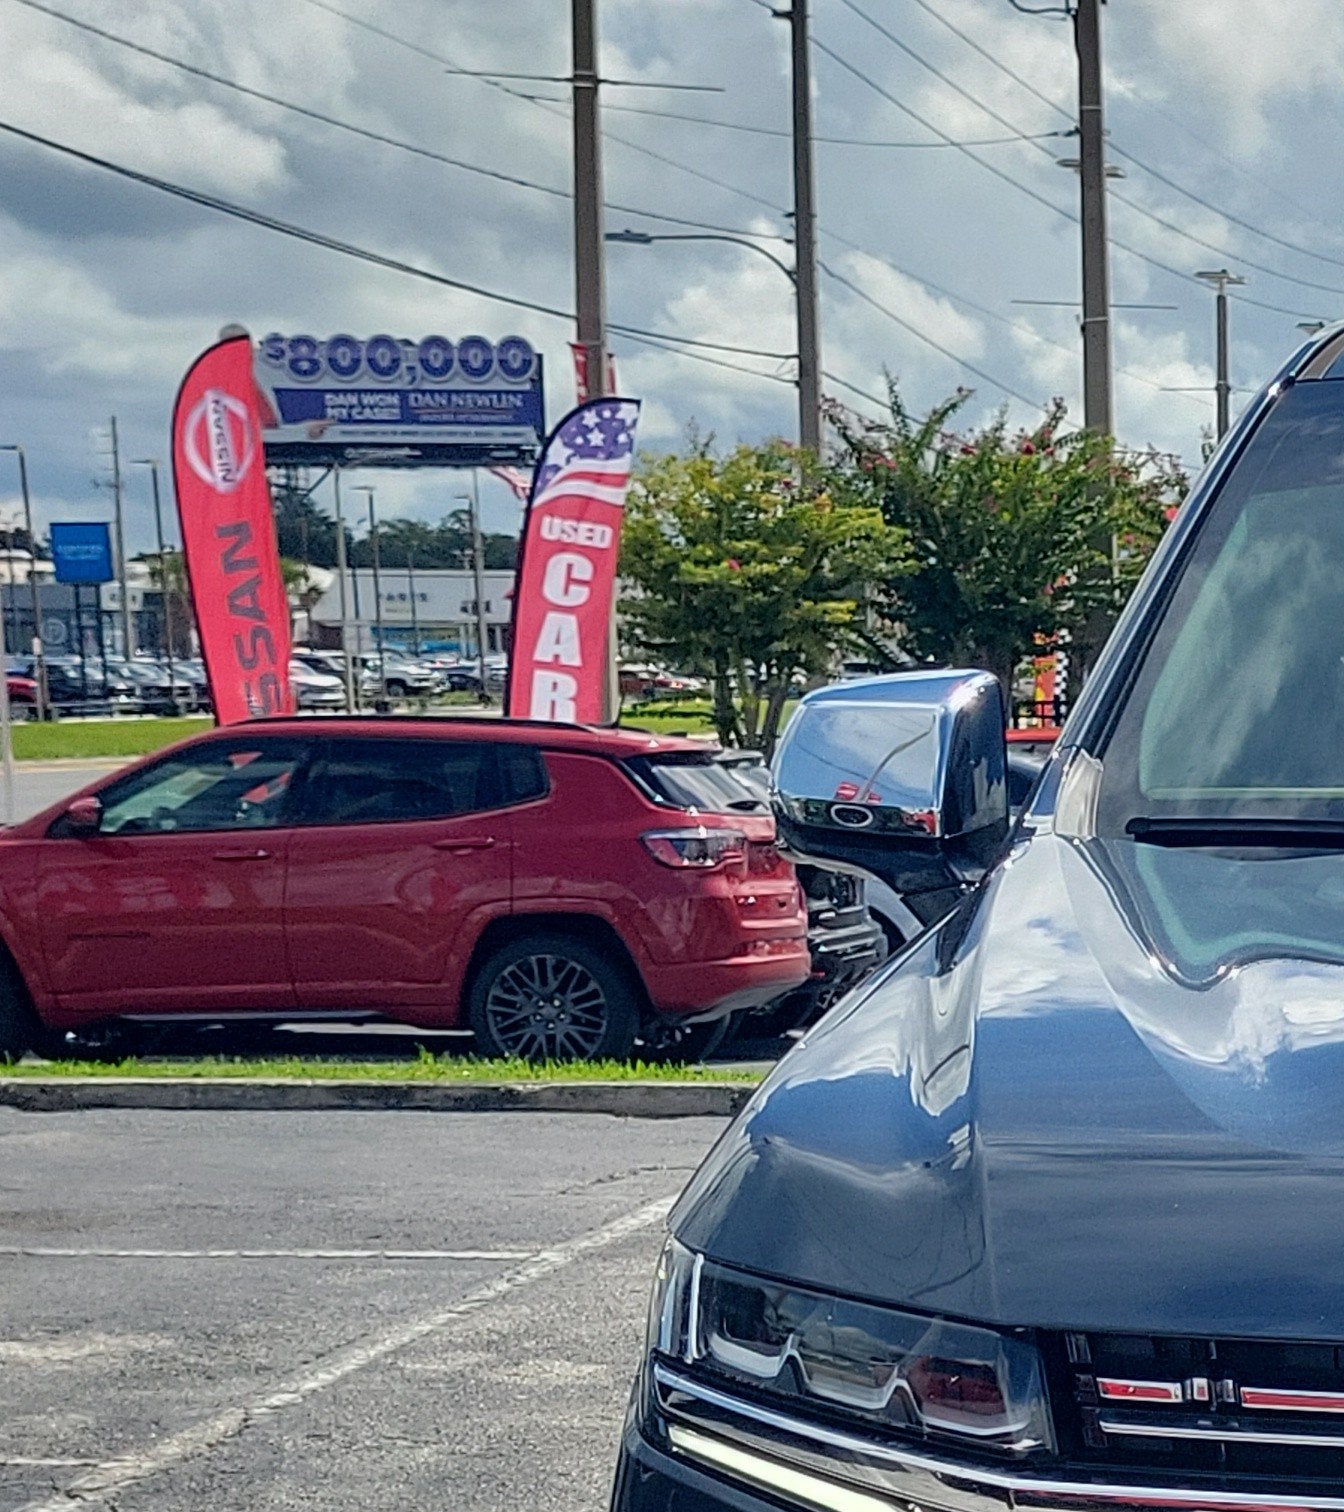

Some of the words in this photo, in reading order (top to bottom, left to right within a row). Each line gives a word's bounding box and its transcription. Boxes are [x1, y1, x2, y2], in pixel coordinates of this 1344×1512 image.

[408, 392, 447, 407] DAN
[212, 399, 240, 483] NISSAN
[539, 515, 613, 549] USED
[530, 552, 595, 724] CAR
